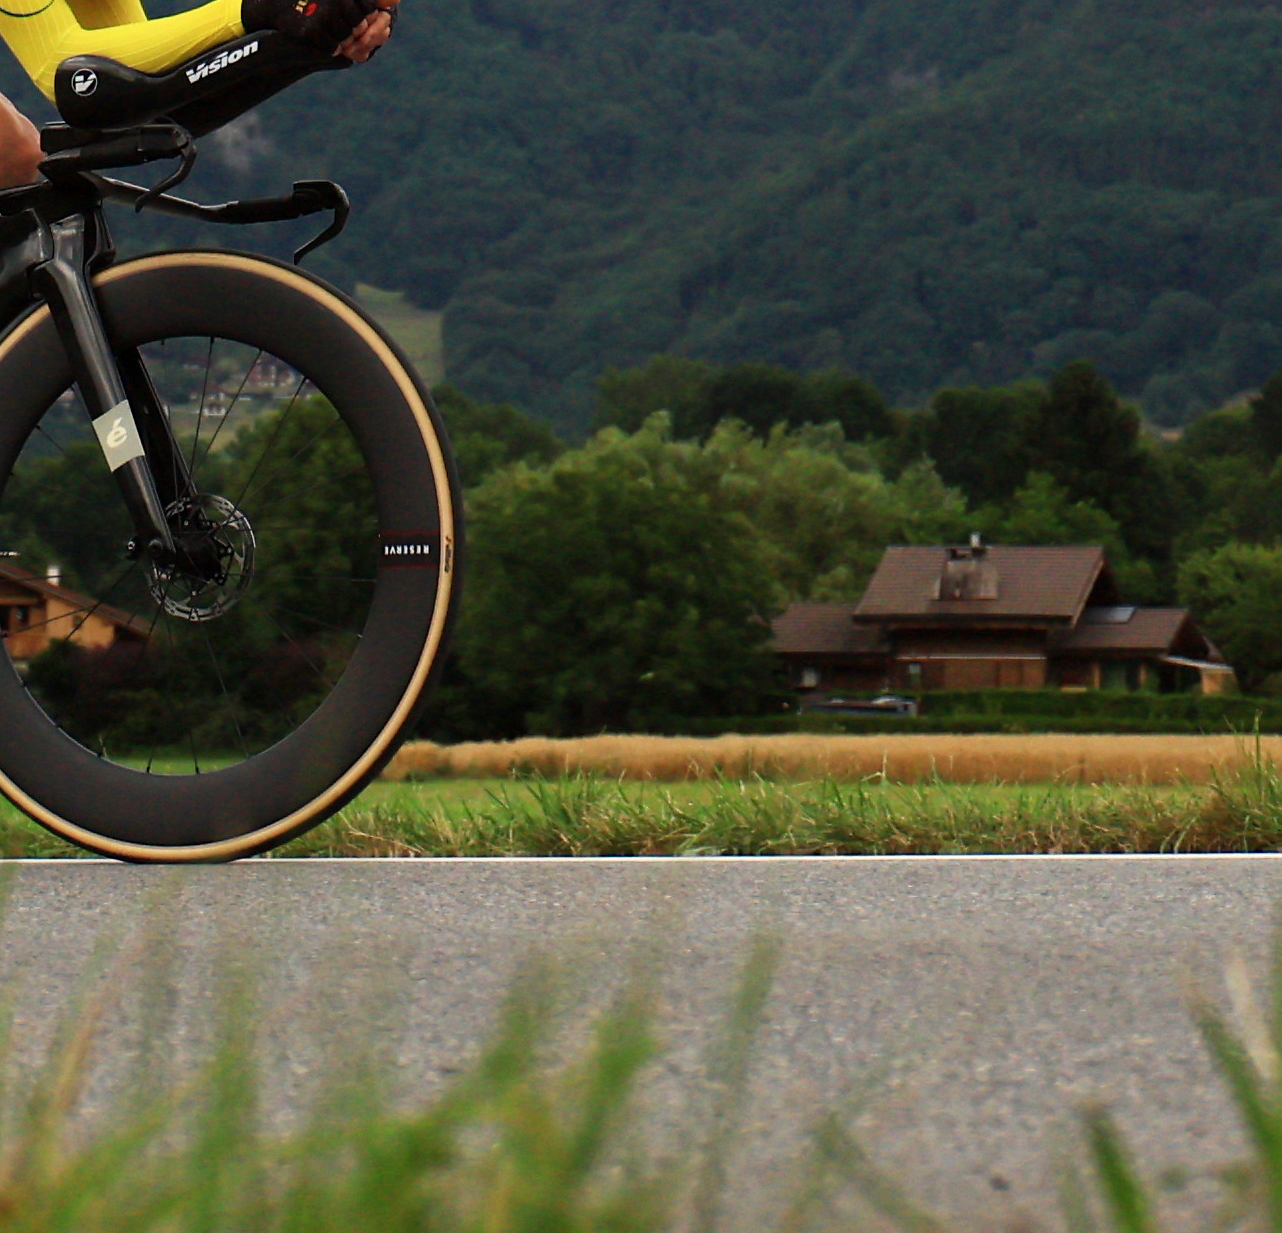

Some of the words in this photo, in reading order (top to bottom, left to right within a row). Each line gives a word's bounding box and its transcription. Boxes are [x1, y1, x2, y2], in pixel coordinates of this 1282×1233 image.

[186, 40, 259, 85] Vision
[105, 418, 126, 448] é
[384, 544, 430, 554] RESERVE
